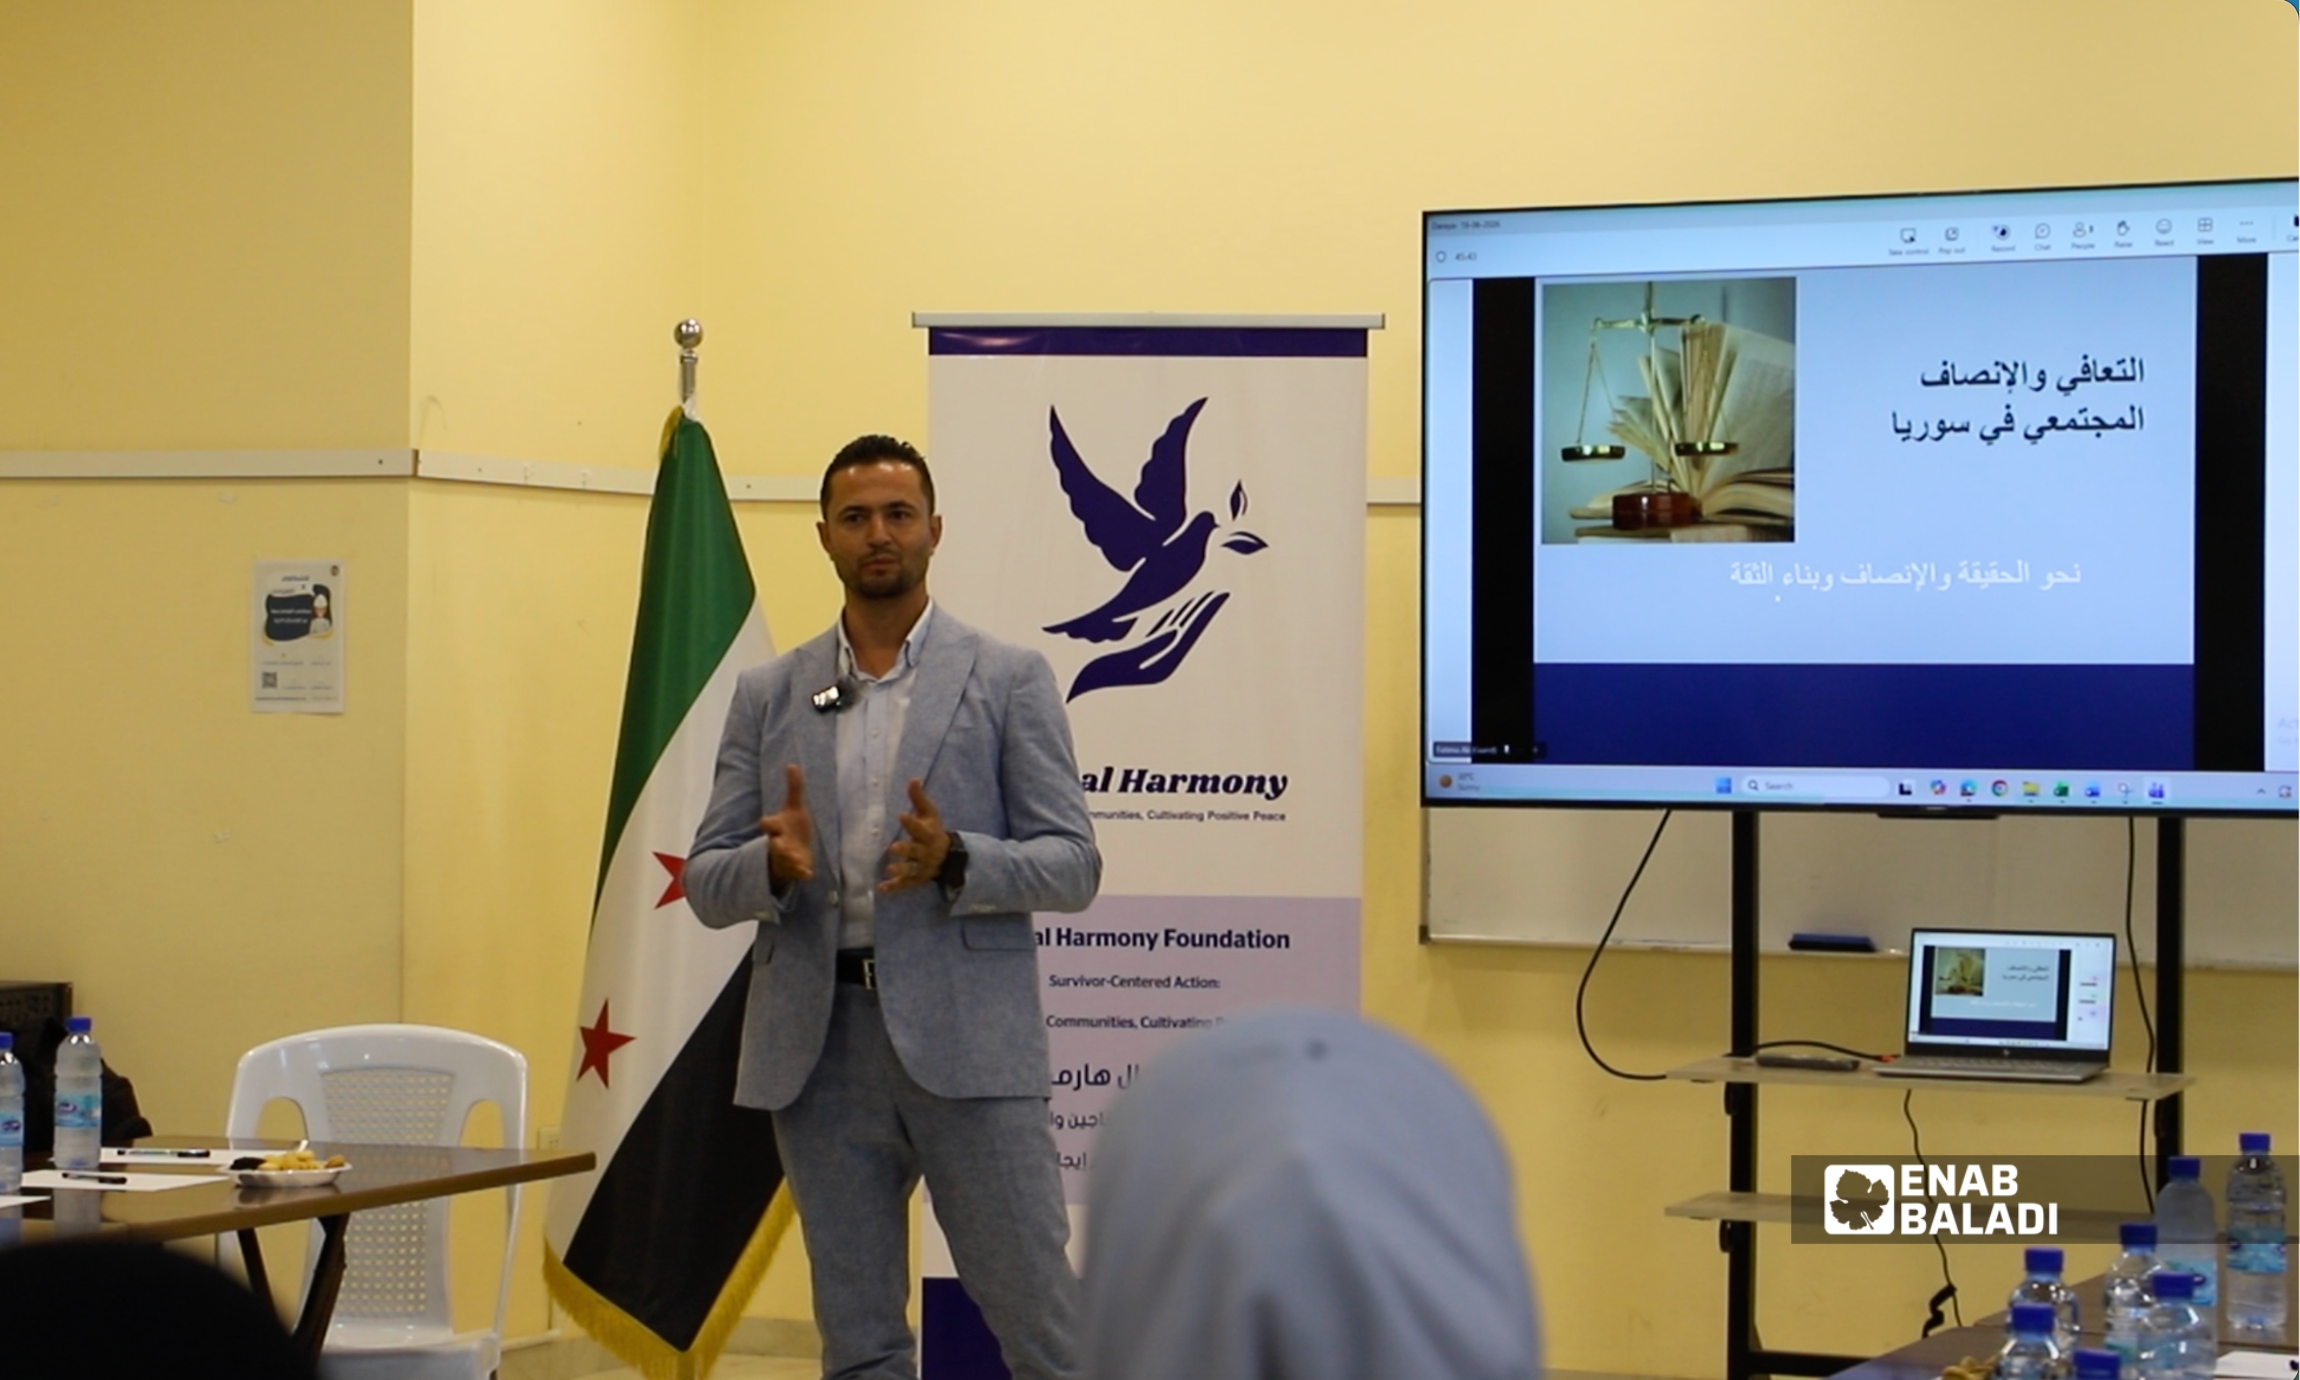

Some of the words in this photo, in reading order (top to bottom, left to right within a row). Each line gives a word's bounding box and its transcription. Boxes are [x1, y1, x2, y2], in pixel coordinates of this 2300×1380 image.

[1920, 360, 2048, 395] والإنصاف
[2056, 353, 2145, 397] التعافي
[1891, 411, 1970, 442] سوريا
[1978, 403, 2015, 447] في
[2022, 404, 2145, 446] المجتمعي
[1730, 561, 1773, 587] الثقة
[1782, 563, 1834, 592] وبناء
[1840, 563, 1952, 593] والإنصاف
[1958, 560, 2029, 590] الحقيقة
[2039, 562, 2081, 591] نحو
[1081, 767, 1114, 793] al
[1117, 769, 1288, 801] Harmony
[1765, 781, 1794, 791] Search
[1089, 810, 1144, 822] munities,
[1147, 810, 1204, 822] Cultivating
[1207, 810, 1250, 821] Positive
[1253, 811, 1287, 821] Peace
[1034, 928, 1050, 946] al
[1056, 928, 1159, 951] Harmony
[1164, 929, 1291, 948] Foundation
[1049, 974, 1171, 988] Survivor-Centered
[1174, 977, 1221, 989] Action:
[1046, 1015, 1138, 1029] Communities,
[1140, 1016, 1213, 1030] Cultivating
